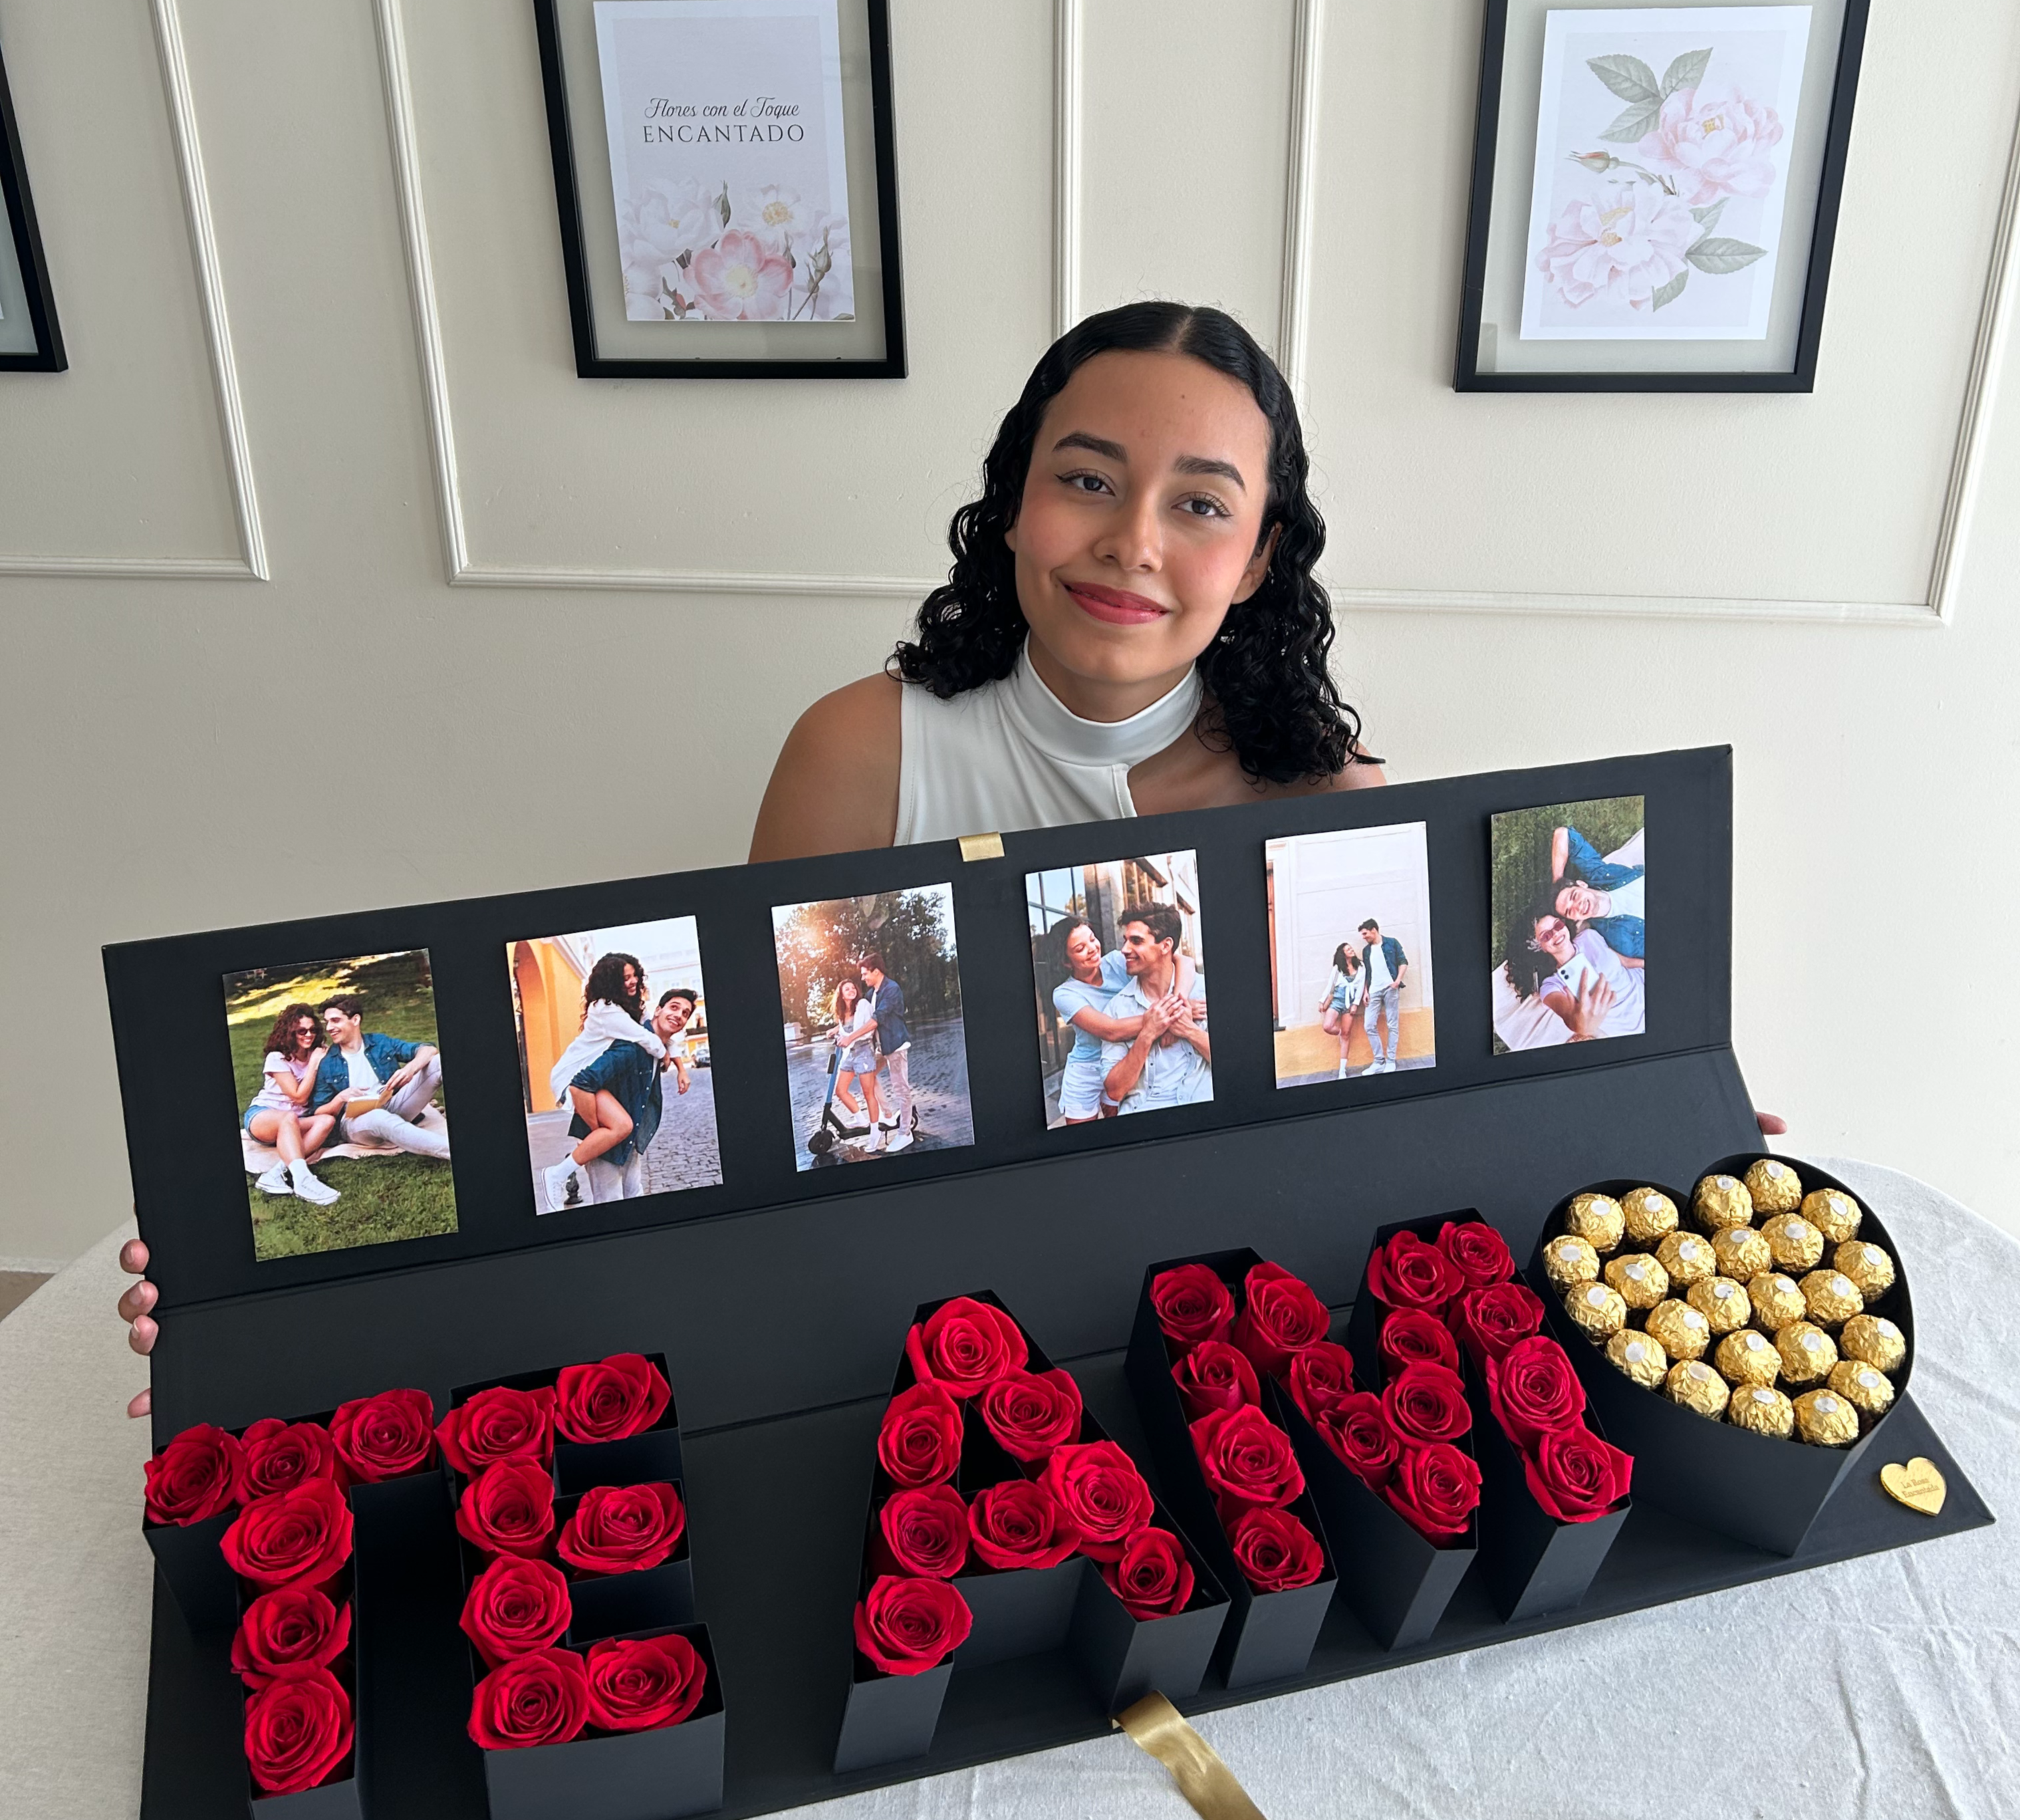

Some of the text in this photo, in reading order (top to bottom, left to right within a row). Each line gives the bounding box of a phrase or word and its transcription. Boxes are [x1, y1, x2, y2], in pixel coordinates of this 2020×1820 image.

[644, 96, 801, 119] Flores con el Toque
[643, 124, 805, 143] ENCANTADO
